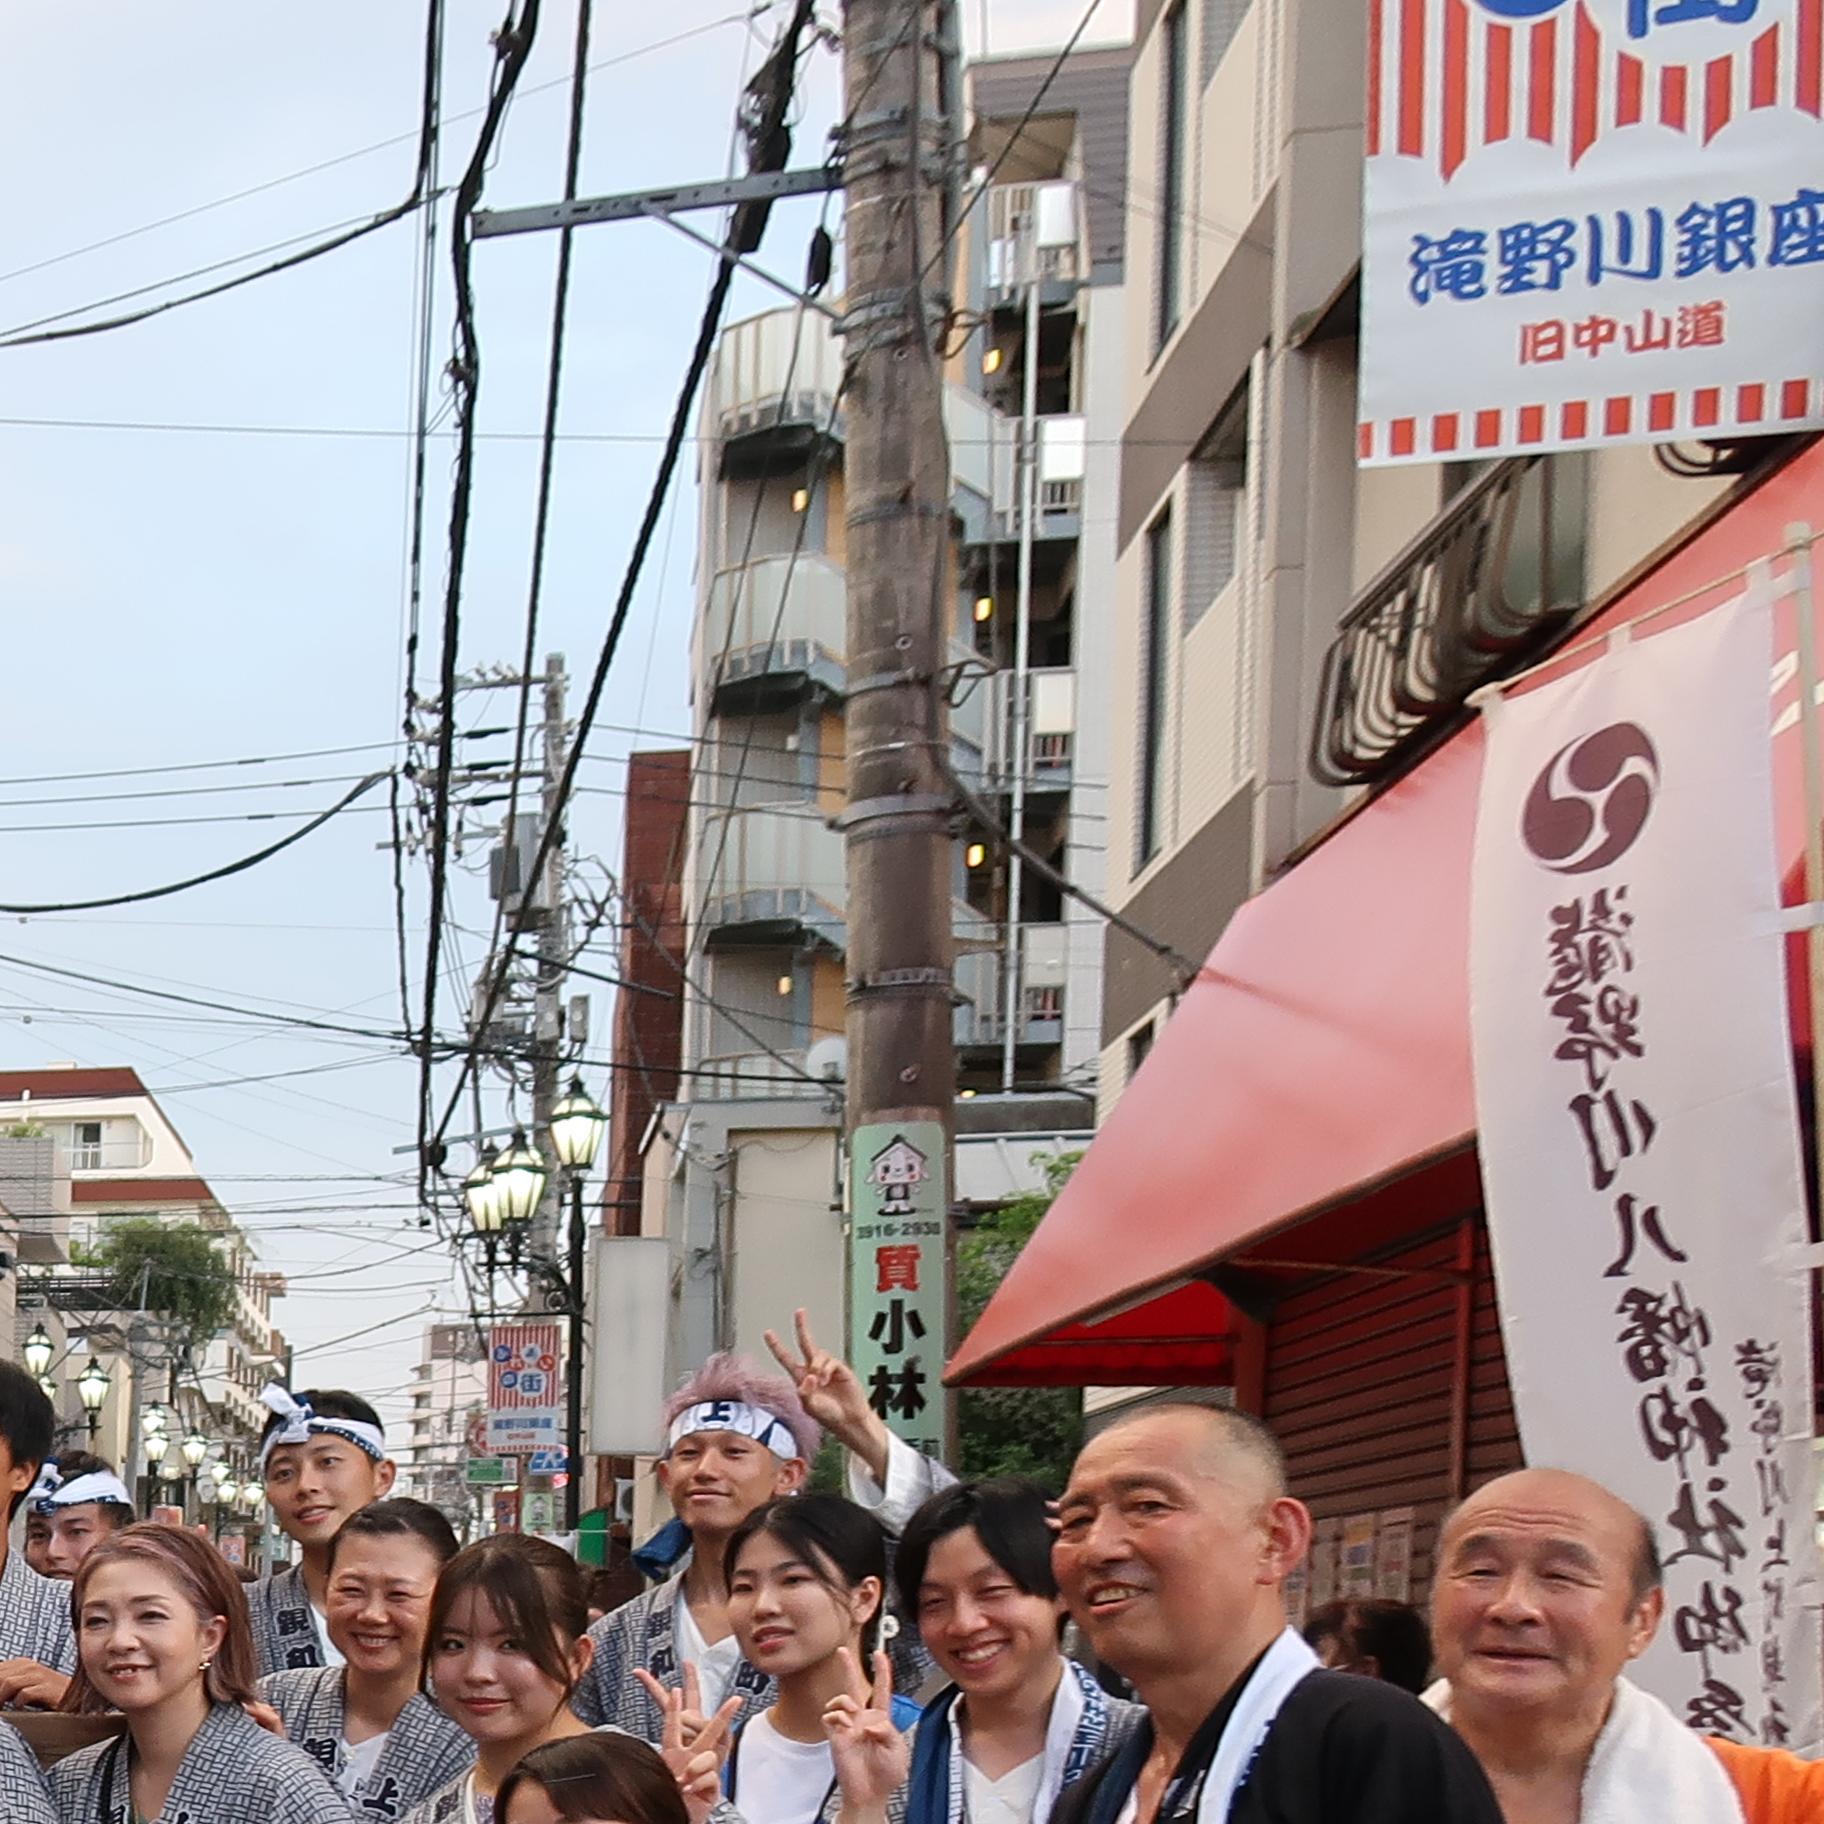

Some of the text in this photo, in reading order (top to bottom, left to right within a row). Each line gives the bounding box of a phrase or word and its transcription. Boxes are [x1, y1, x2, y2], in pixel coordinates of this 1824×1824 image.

[1518, 301, 1726, 366] 旧中山道
[875, 1243, 923, 1293] 質
[867, 1298, 927, 1420] 小林
